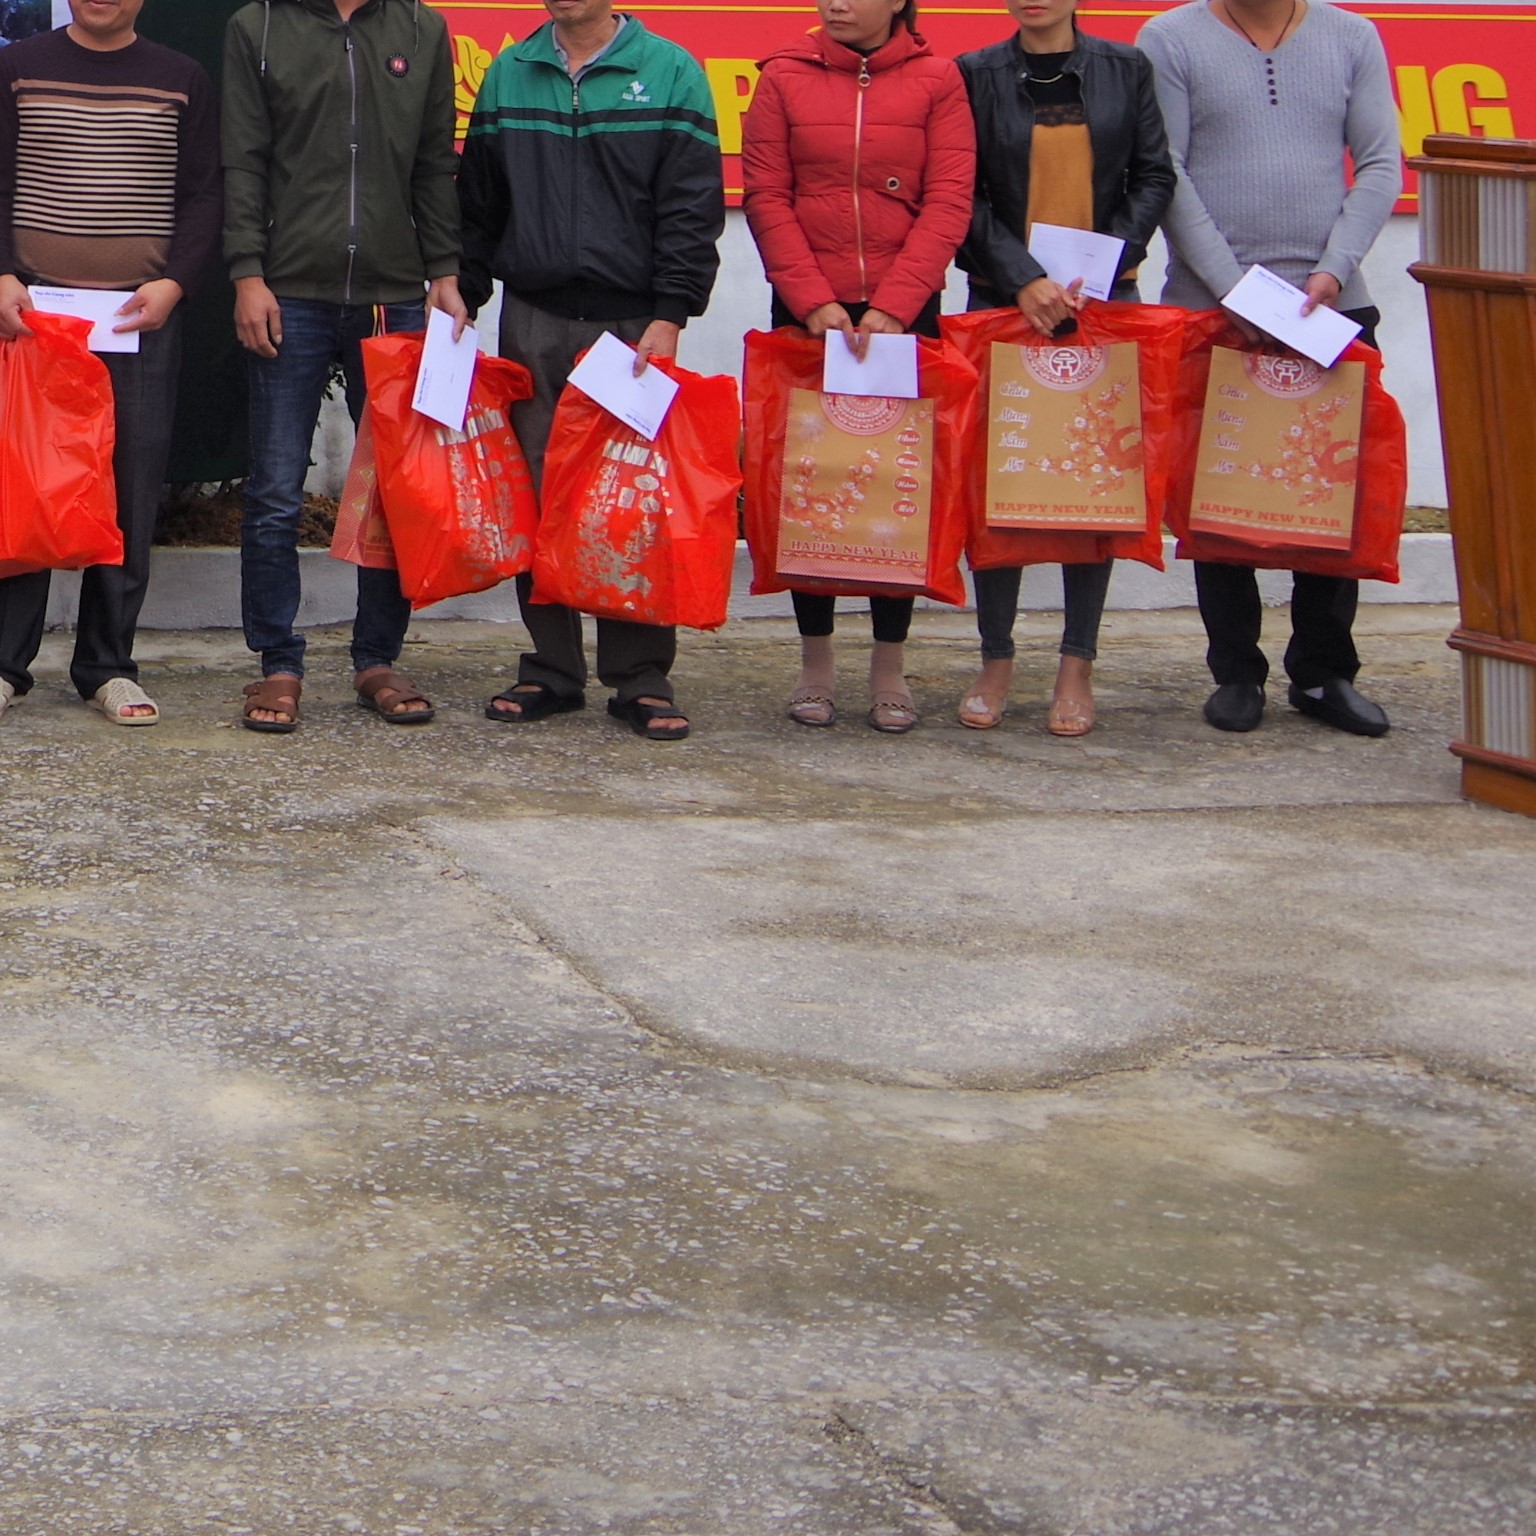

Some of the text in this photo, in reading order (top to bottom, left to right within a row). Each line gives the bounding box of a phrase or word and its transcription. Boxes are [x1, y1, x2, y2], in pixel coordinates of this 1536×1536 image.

[995, 502, 1136, 515] HAPPY NEW YEAR
[1199, 502, 1341, 528] HAPPY NEW YEAR
[791, 540, 919, 561] HAPPY NEW YEAR
